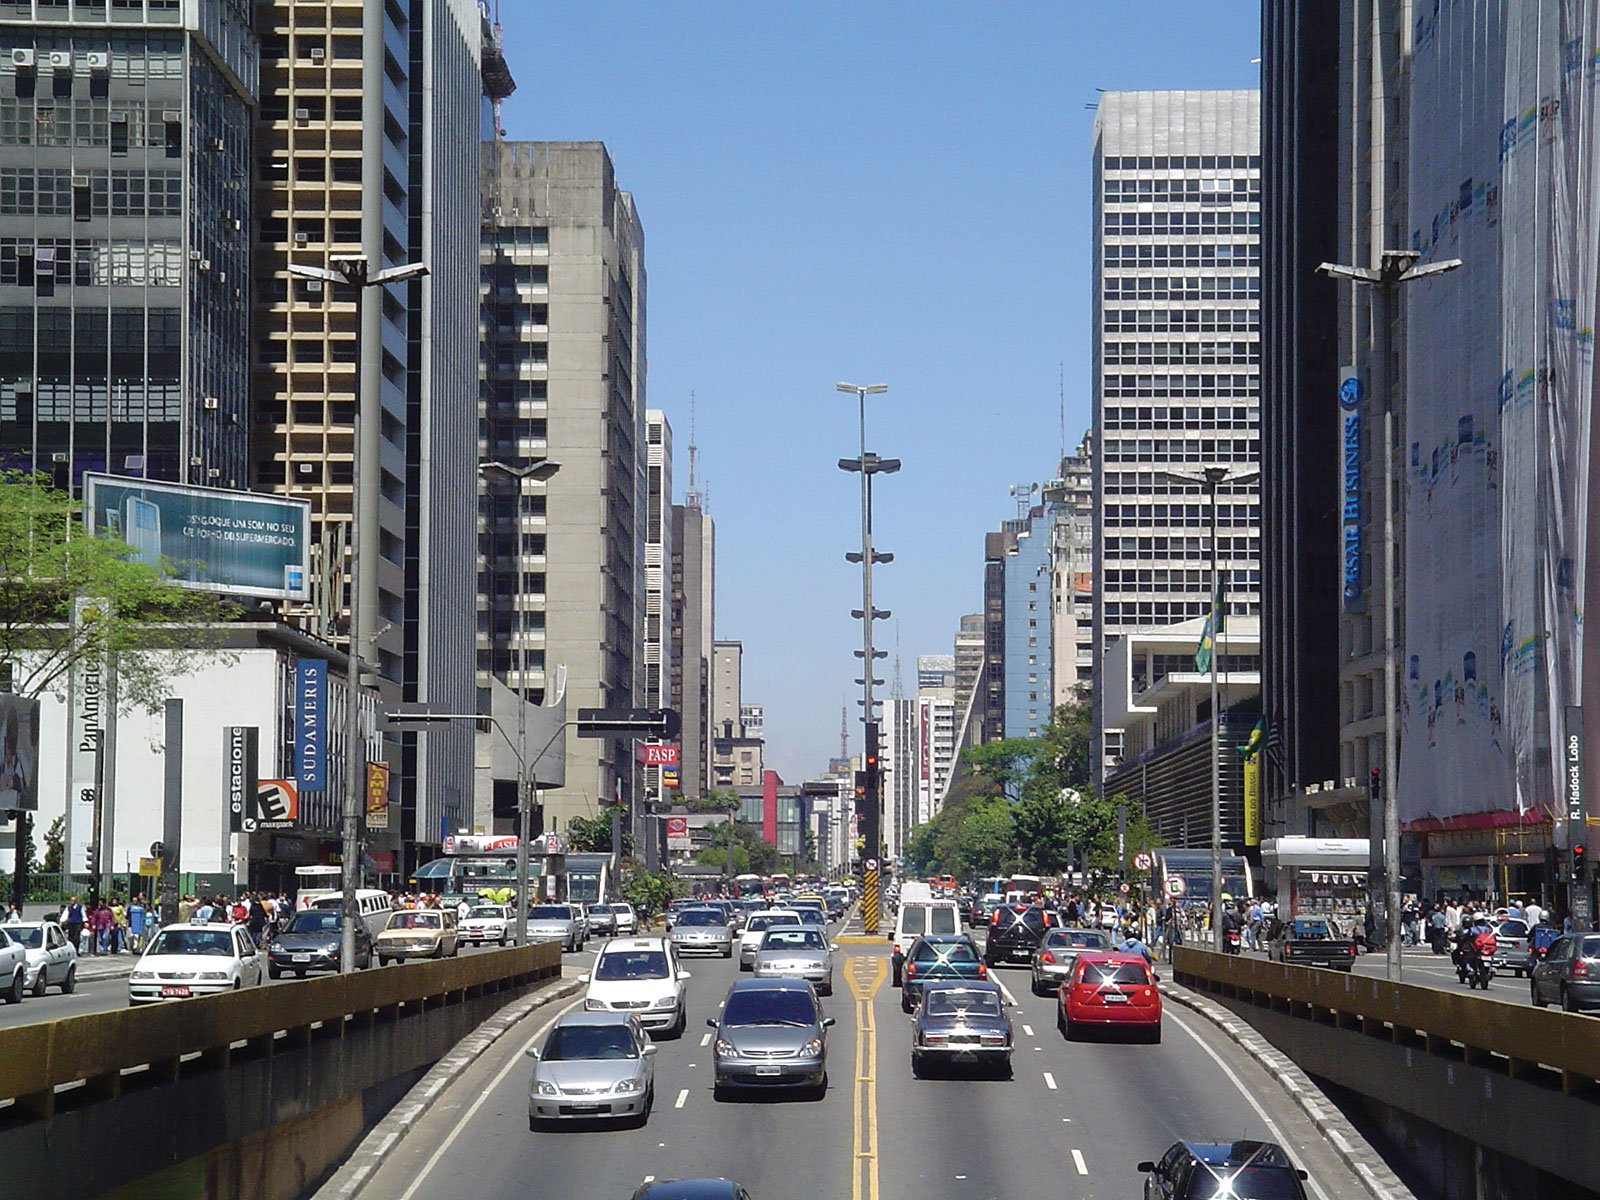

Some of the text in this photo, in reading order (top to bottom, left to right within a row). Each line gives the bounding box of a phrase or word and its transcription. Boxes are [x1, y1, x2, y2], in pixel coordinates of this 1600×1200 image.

[1342, 415, 1360, 520] BUSINESS
[266, 522, 279, 532] NO
[281, 523, 295, 534] SEU
[304, 668, 317, 781] SUDAMERIS
[648, 748, 676, 762] FASP
[231, 727, 242, 813] estacione
[1568, 734, 1581, 820] R. Hadock Lobo
[260, 821, 294, 829] maxipark
